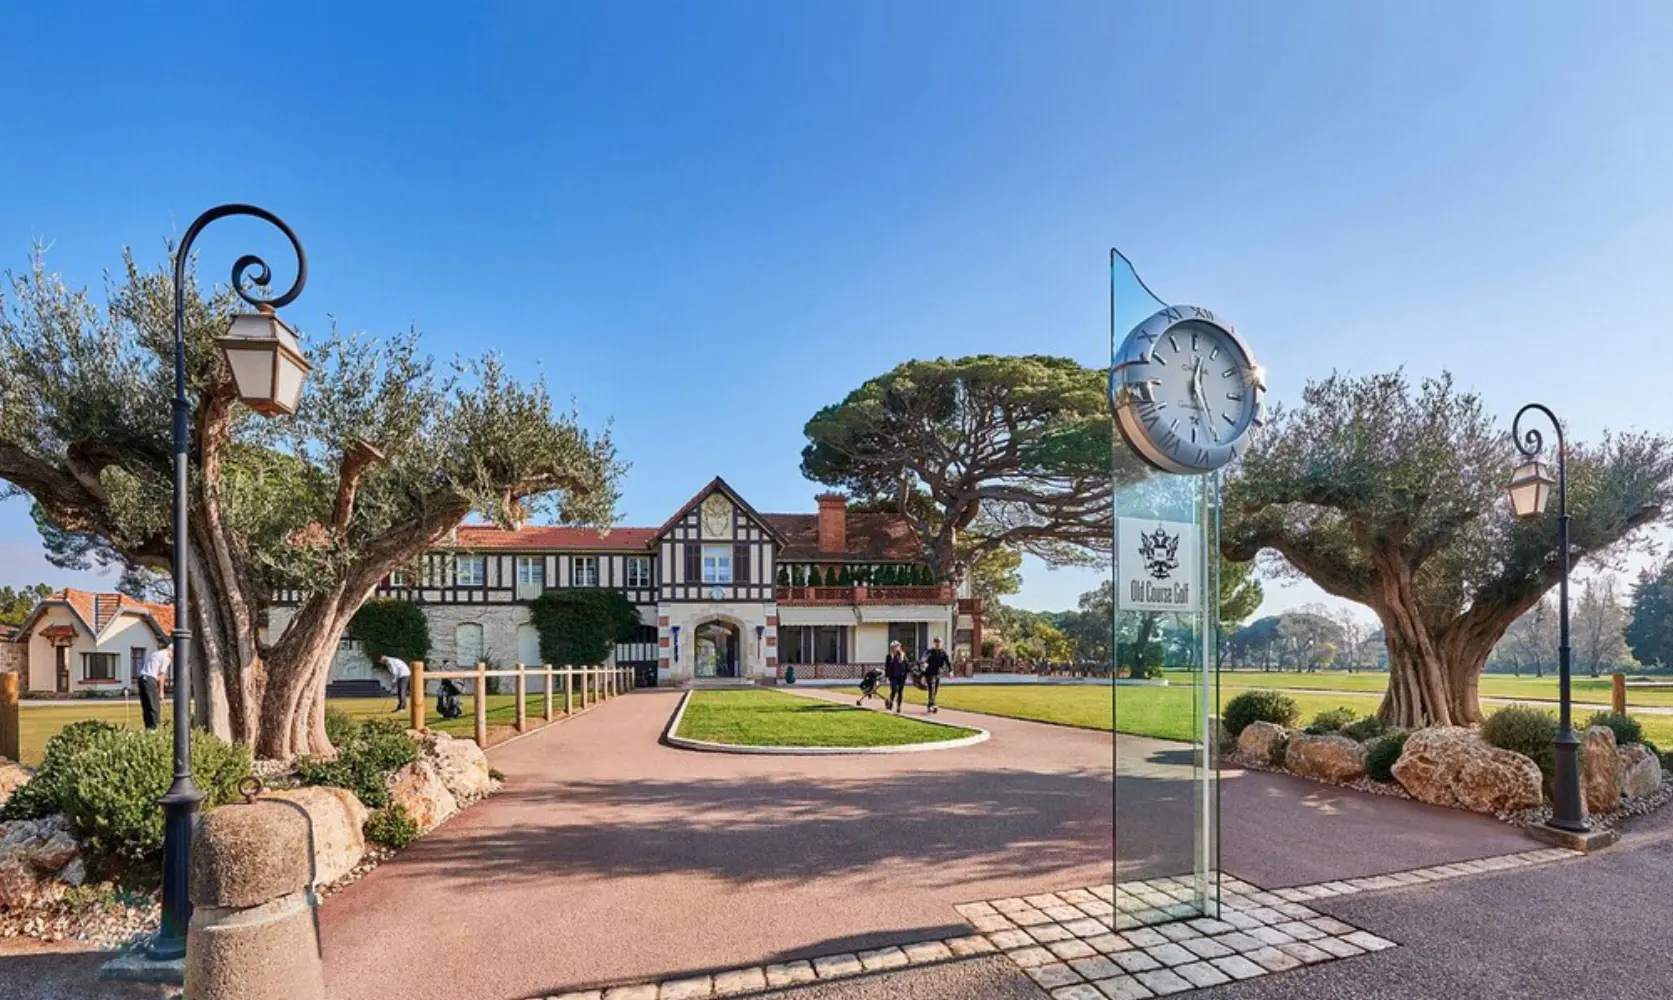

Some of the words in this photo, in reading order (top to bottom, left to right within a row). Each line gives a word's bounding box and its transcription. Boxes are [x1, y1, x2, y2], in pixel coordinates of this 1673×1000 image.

[1131, 580, 1144, 602] Old
[1146, 580, 1172, 603] Course
[1174, 581, 1188, 604] Golf
